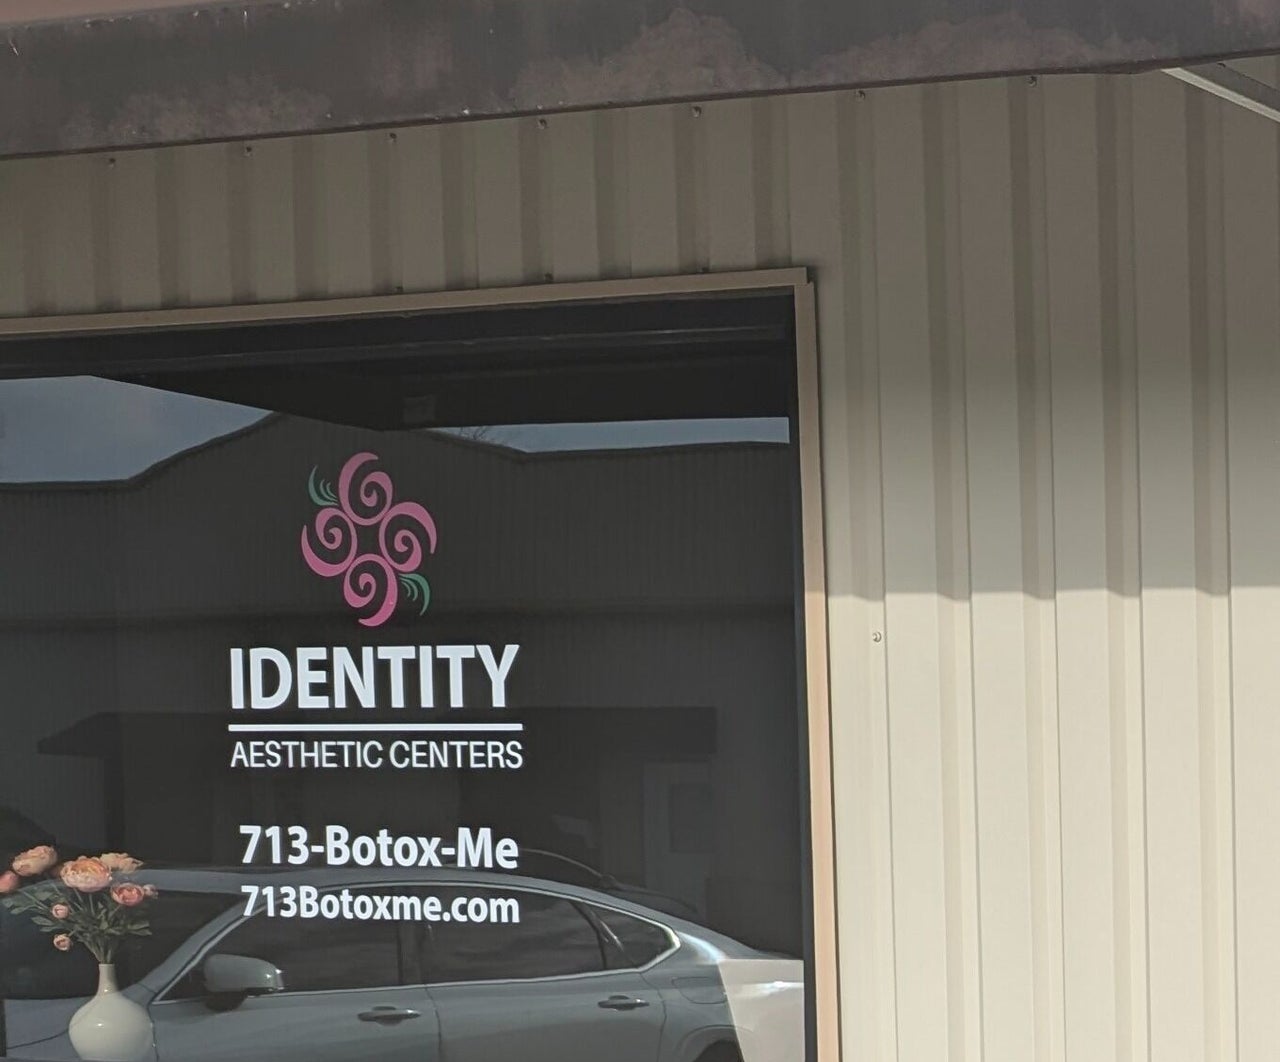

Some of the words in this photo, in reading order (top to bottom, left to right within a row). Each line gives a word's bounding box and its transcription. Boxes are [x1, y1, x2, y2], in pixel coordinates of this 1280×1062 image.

[230, 644, 520, 710] IDENTITY
[230, 740, 384, 769] AESTHETIC
[389, 740, 523, 769] CENTERS
[239, 824, 519, 869] 713-Botox-Me
[240, 885, 520, 923] 713Botoxme.com
